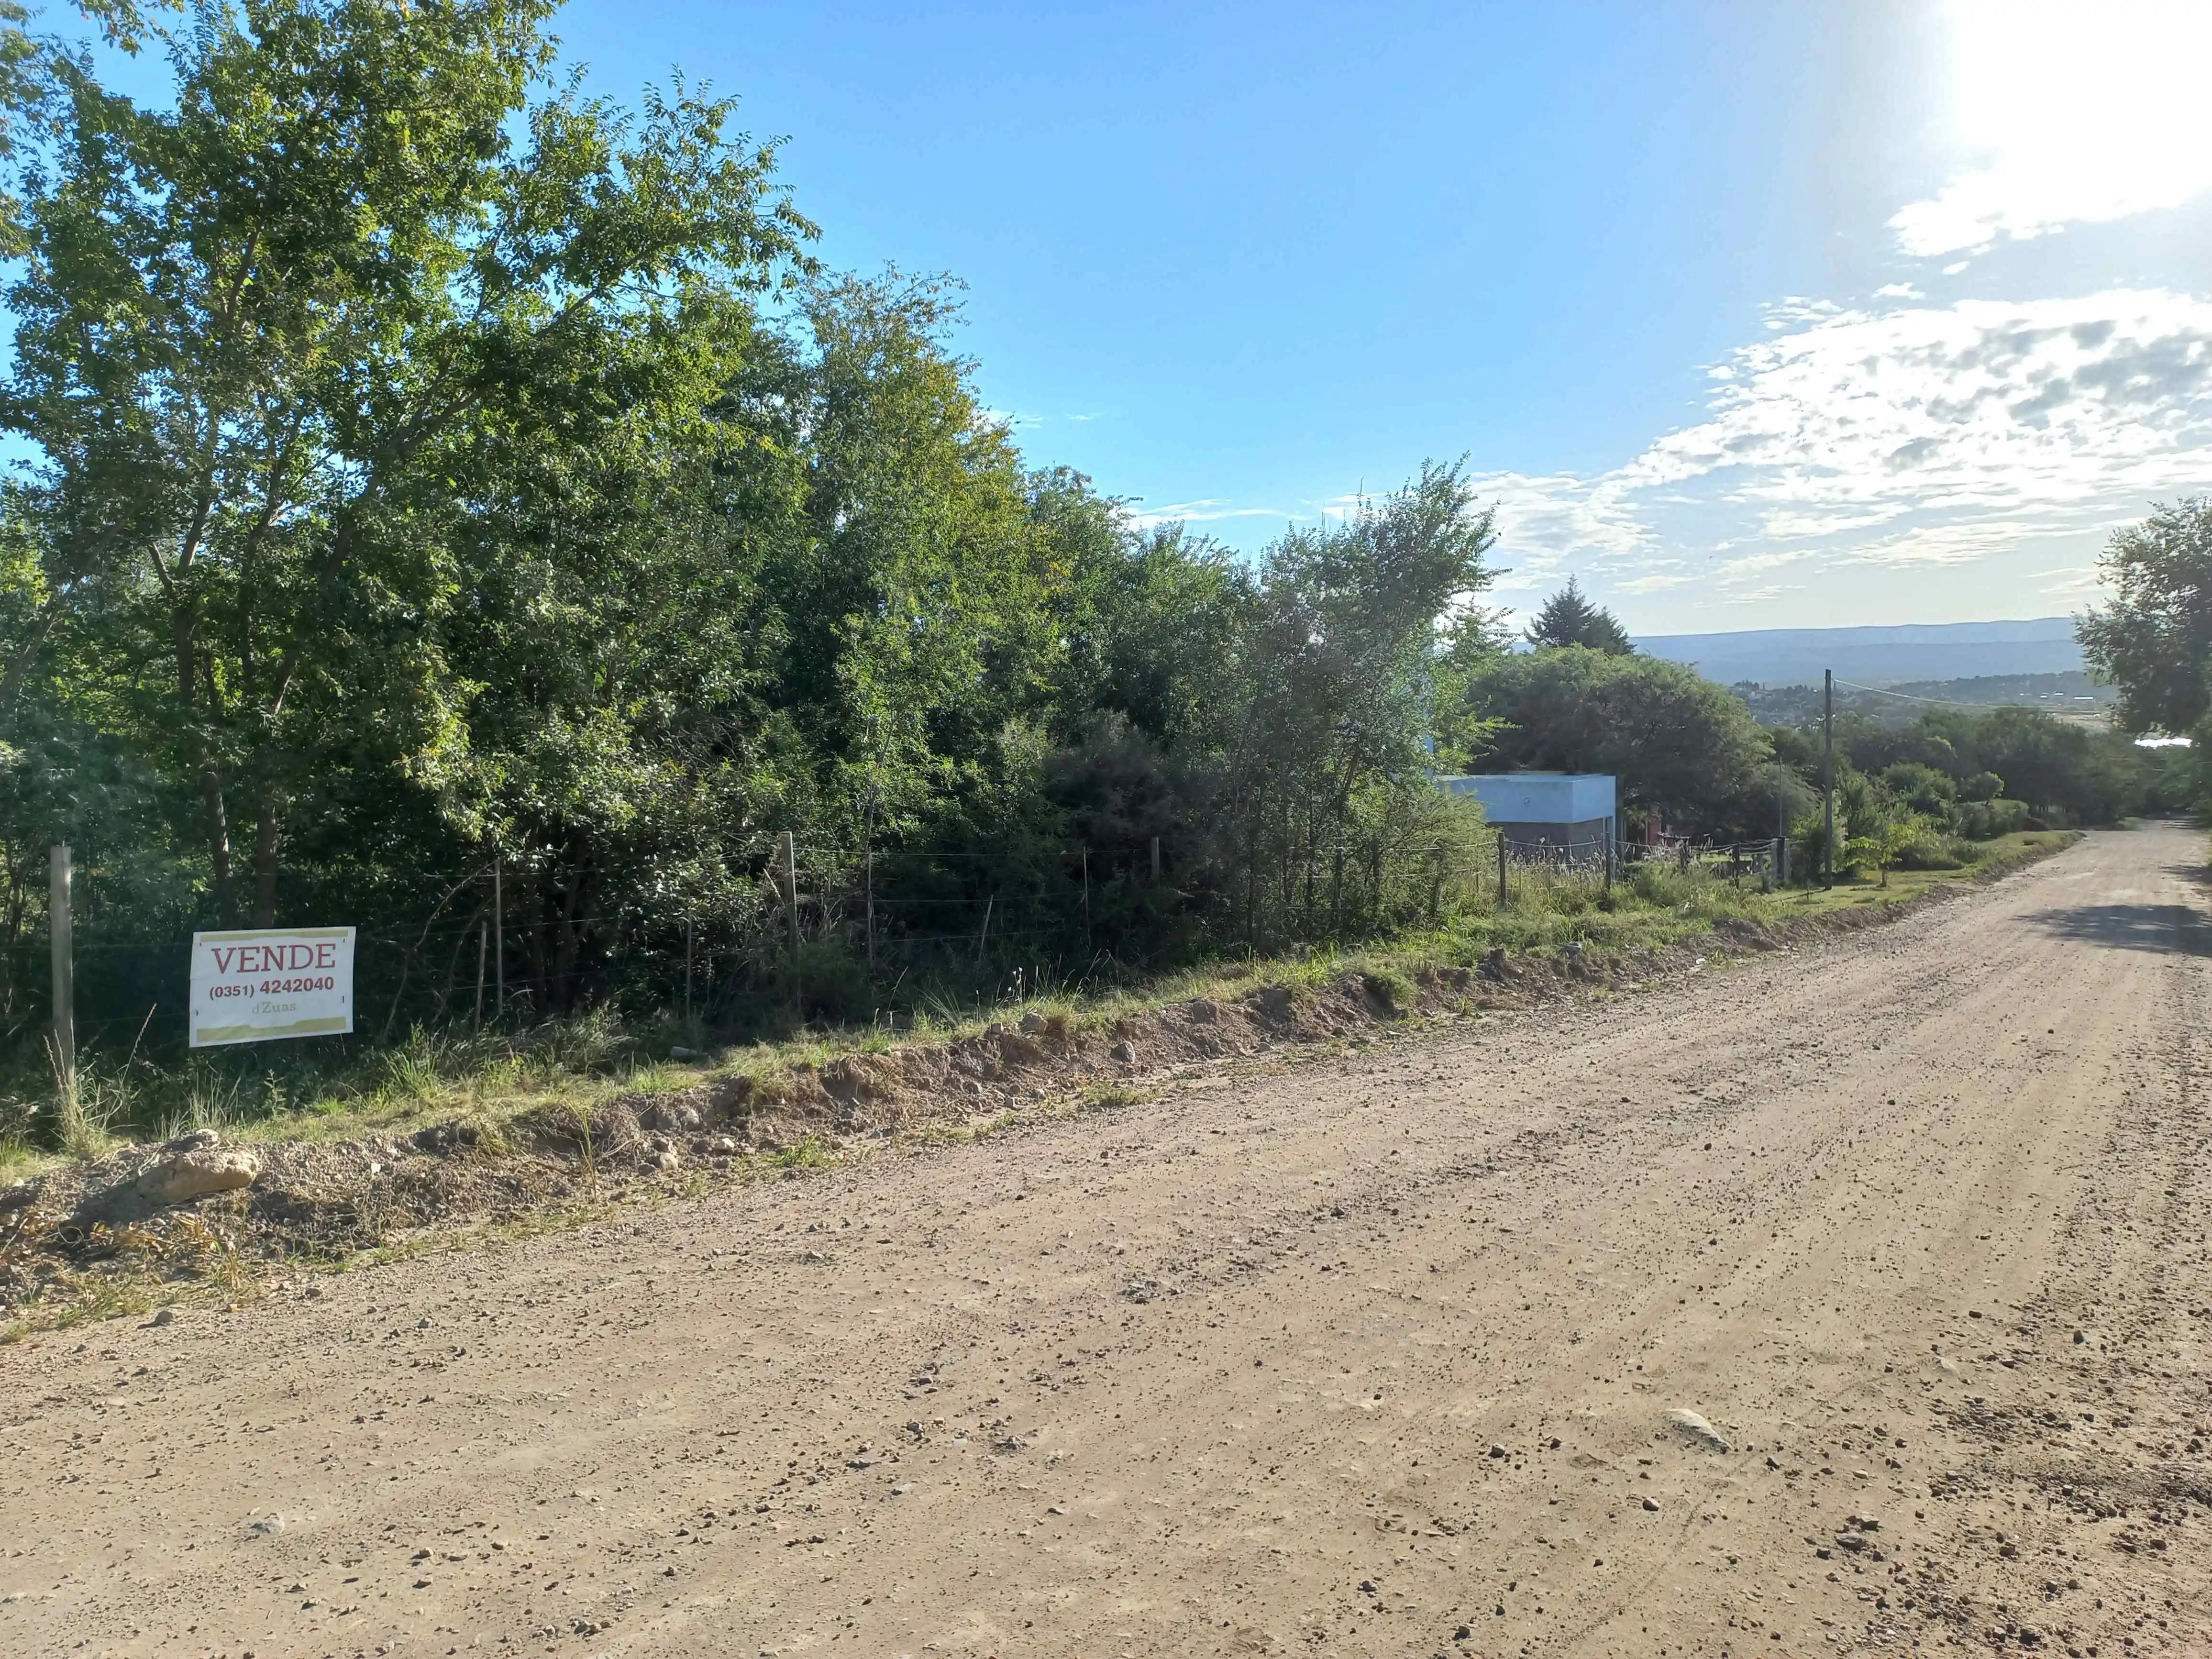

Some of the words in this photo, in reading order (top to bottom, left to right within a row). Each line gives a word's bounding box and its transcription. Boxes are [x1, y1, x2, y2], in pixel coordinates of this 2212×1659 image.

[211, 943, 336, 974] VENDE
[210, 984, 254, 1000] (0351)
[260, 977, 334, 994] 4242040
